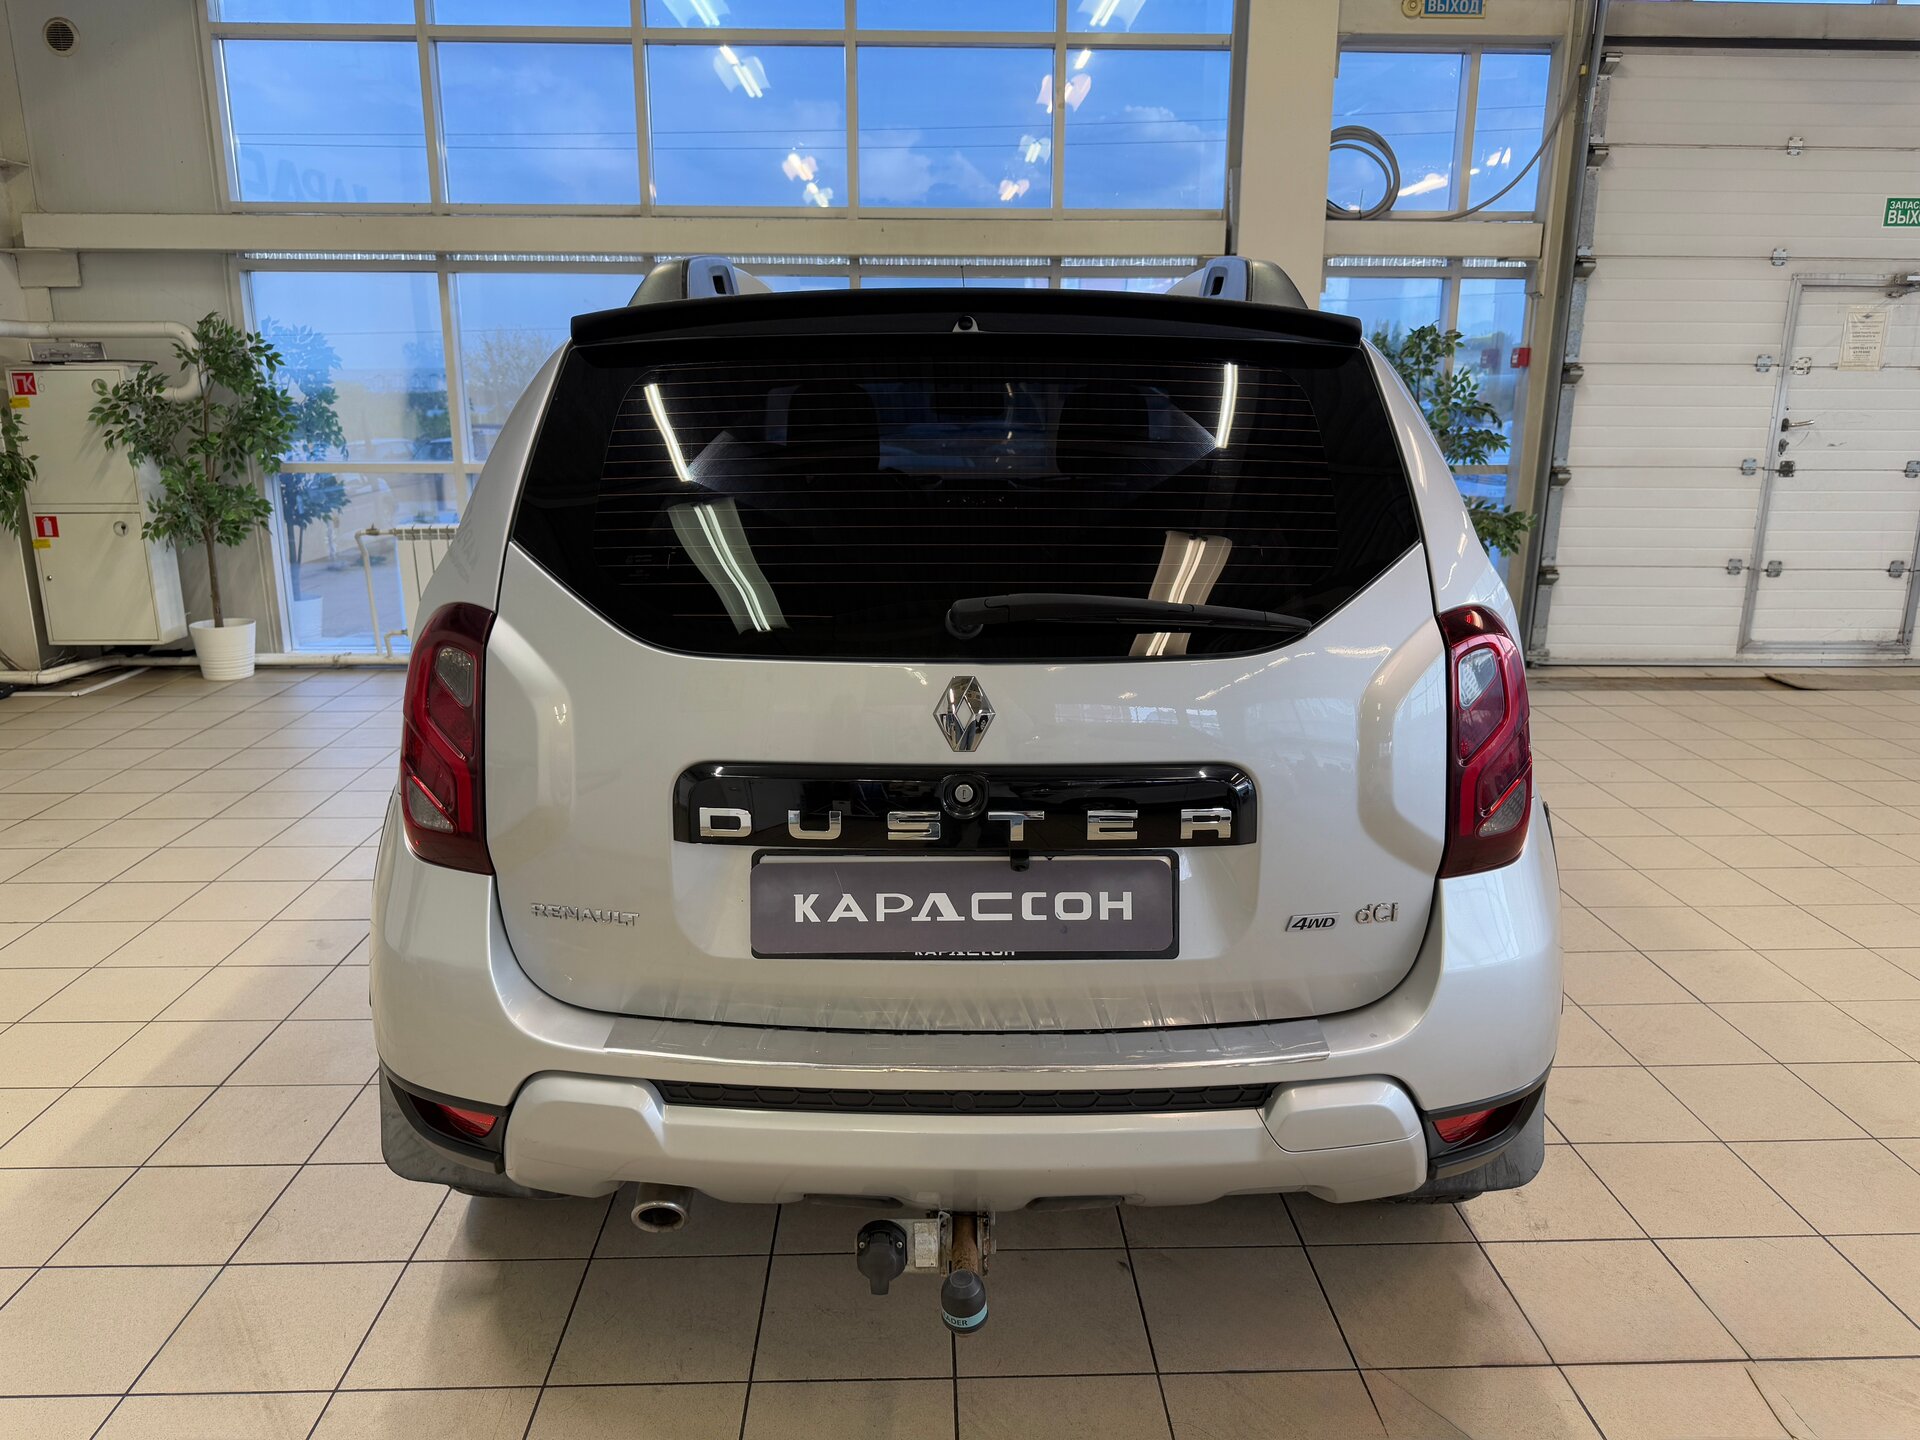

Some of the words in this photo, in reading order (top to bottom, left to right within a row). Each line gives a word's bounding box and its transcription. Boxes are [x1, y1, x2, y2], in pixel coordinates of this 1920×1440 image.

[1427, 0, 1479, 13] ВЫХОД
[1889, 200, 1920, 209] ЗАПАС
[1887, 209, 1920, 224] ВЫХ
[12, 375, 36, 393] ПК
[699, 806, 1233, 840] DUSTER
[530, 902, 640, 927] RENAULT
[793, 891, 1133, 923] КАРАССОН
[1291, 917, 1336, 930] 4WD
